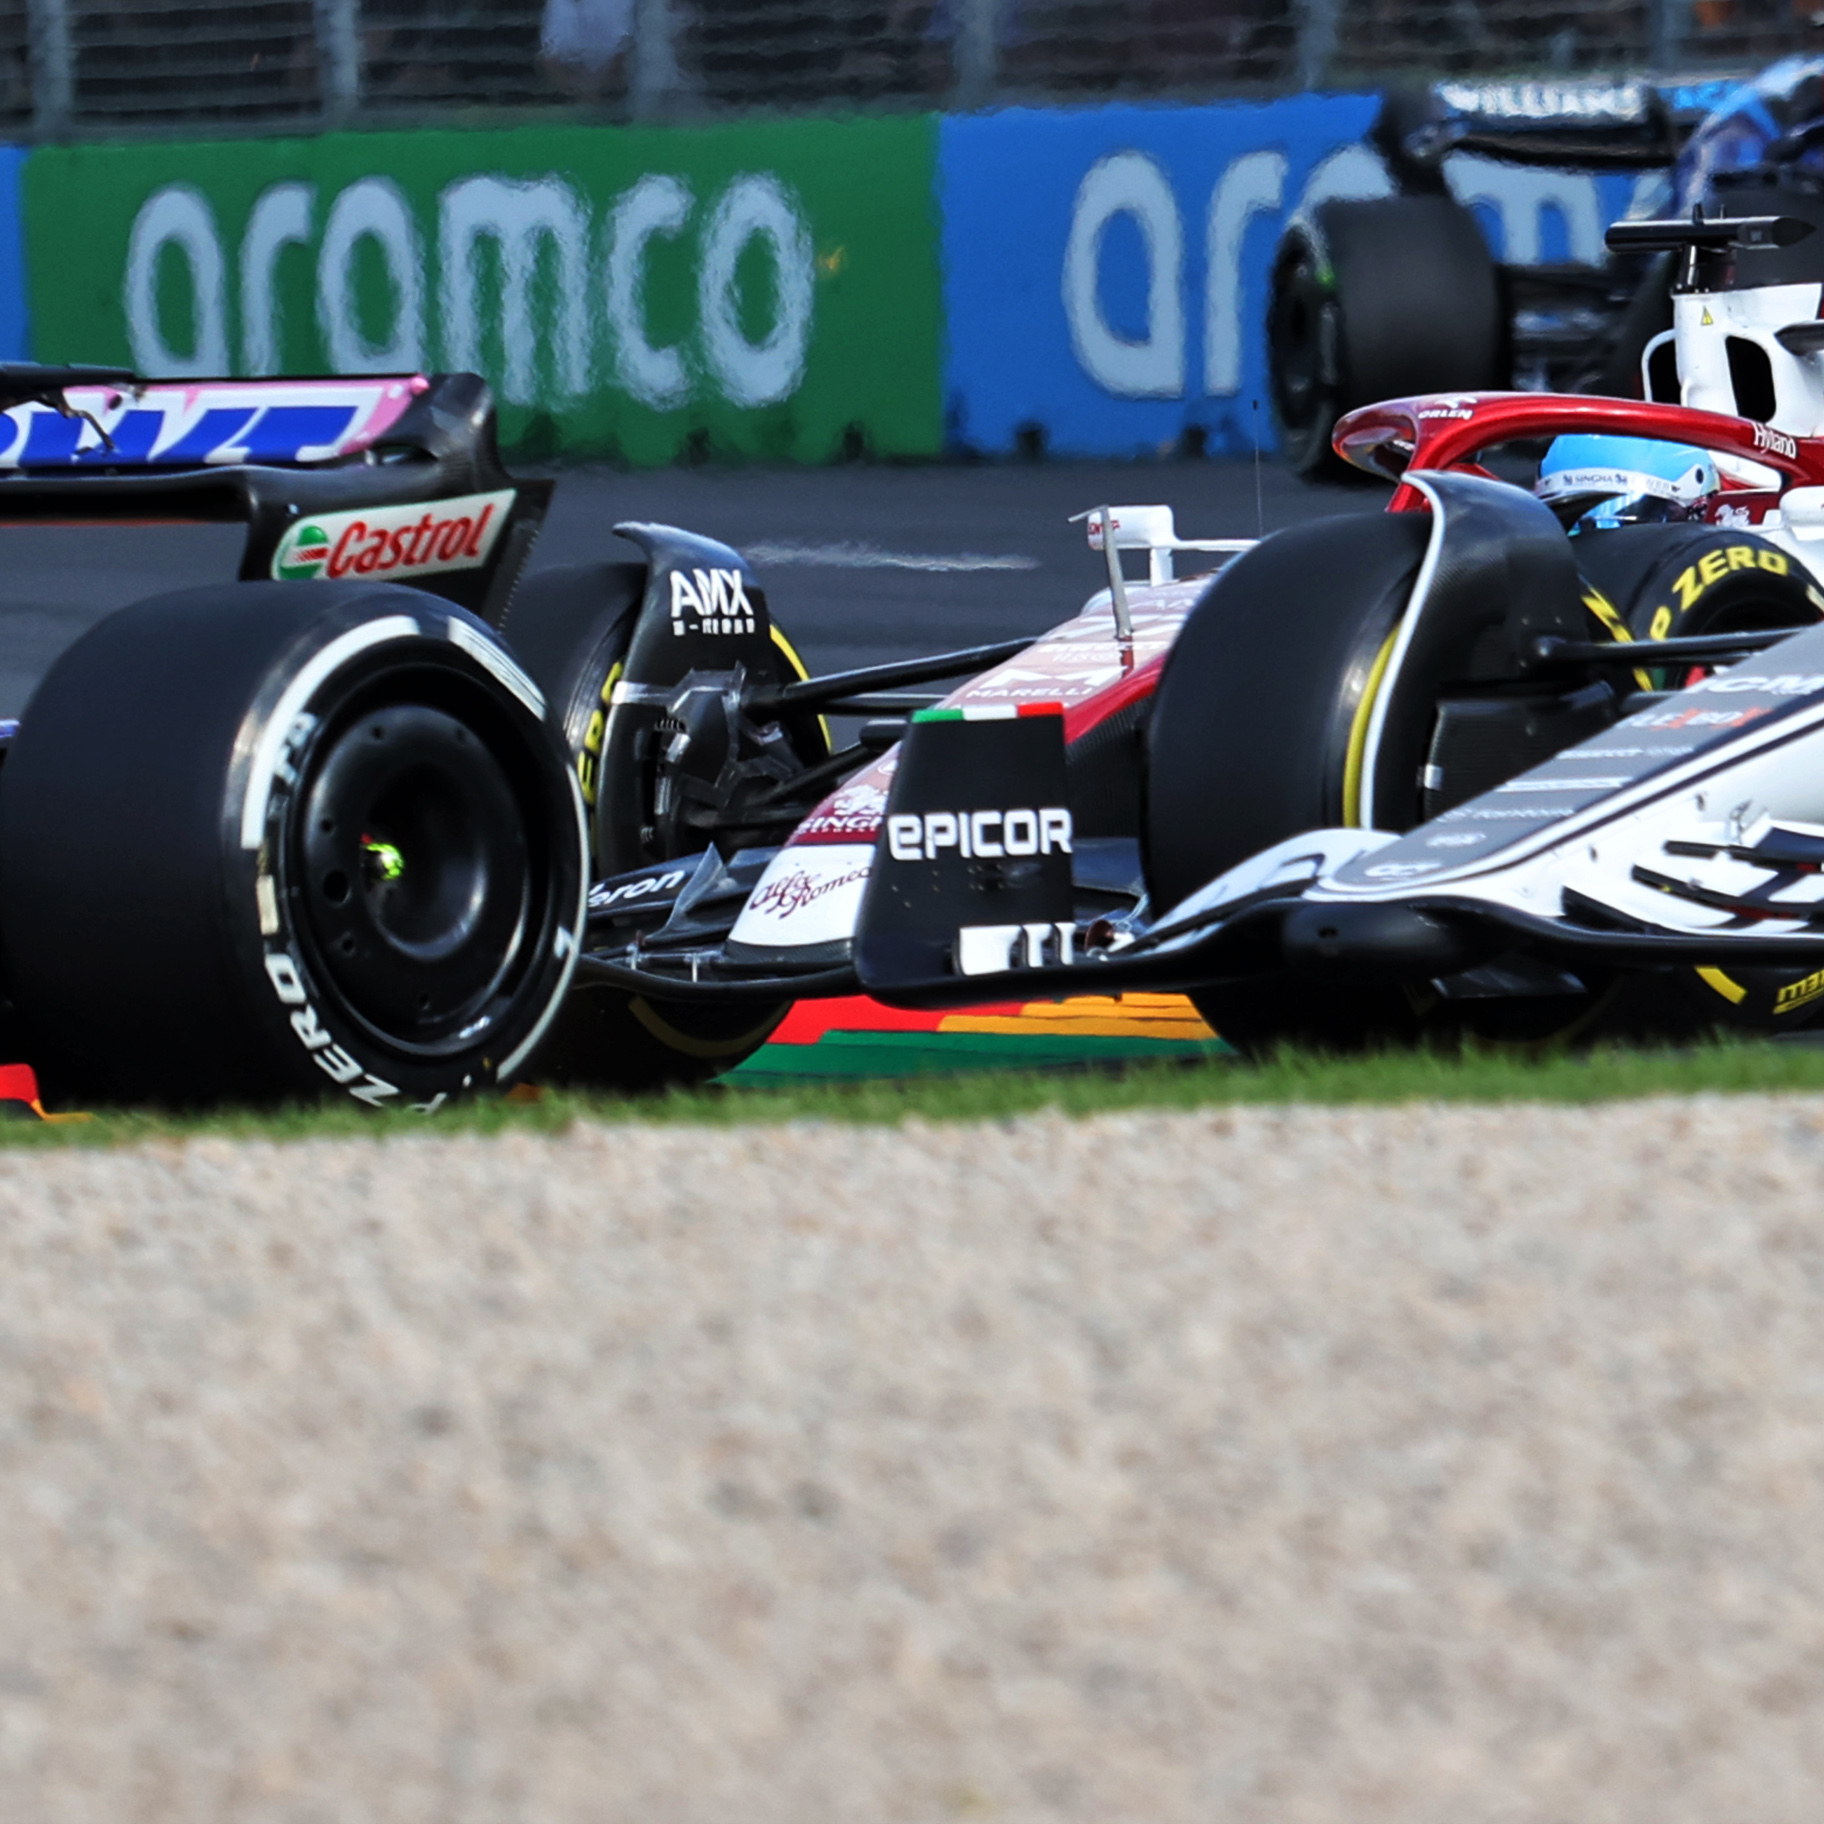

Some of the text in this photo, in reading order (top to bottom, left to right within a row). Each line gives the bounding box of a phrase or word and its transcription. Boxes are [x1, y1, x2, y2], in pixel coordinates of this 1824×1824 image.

[123, 174, 816, 411] aramco
[1418, 408, 1474, 421] ORLEN
[1753, 422, 1797, 460] Hyland
[328, 501, 495, 580] Castrol
[670, 568, 754, 618] AMX
[1671, 545, 1790, 613] ZERO
[966, 687, 1093, 699] MARELLI
[264, 952, 400, 1107] ZERO
